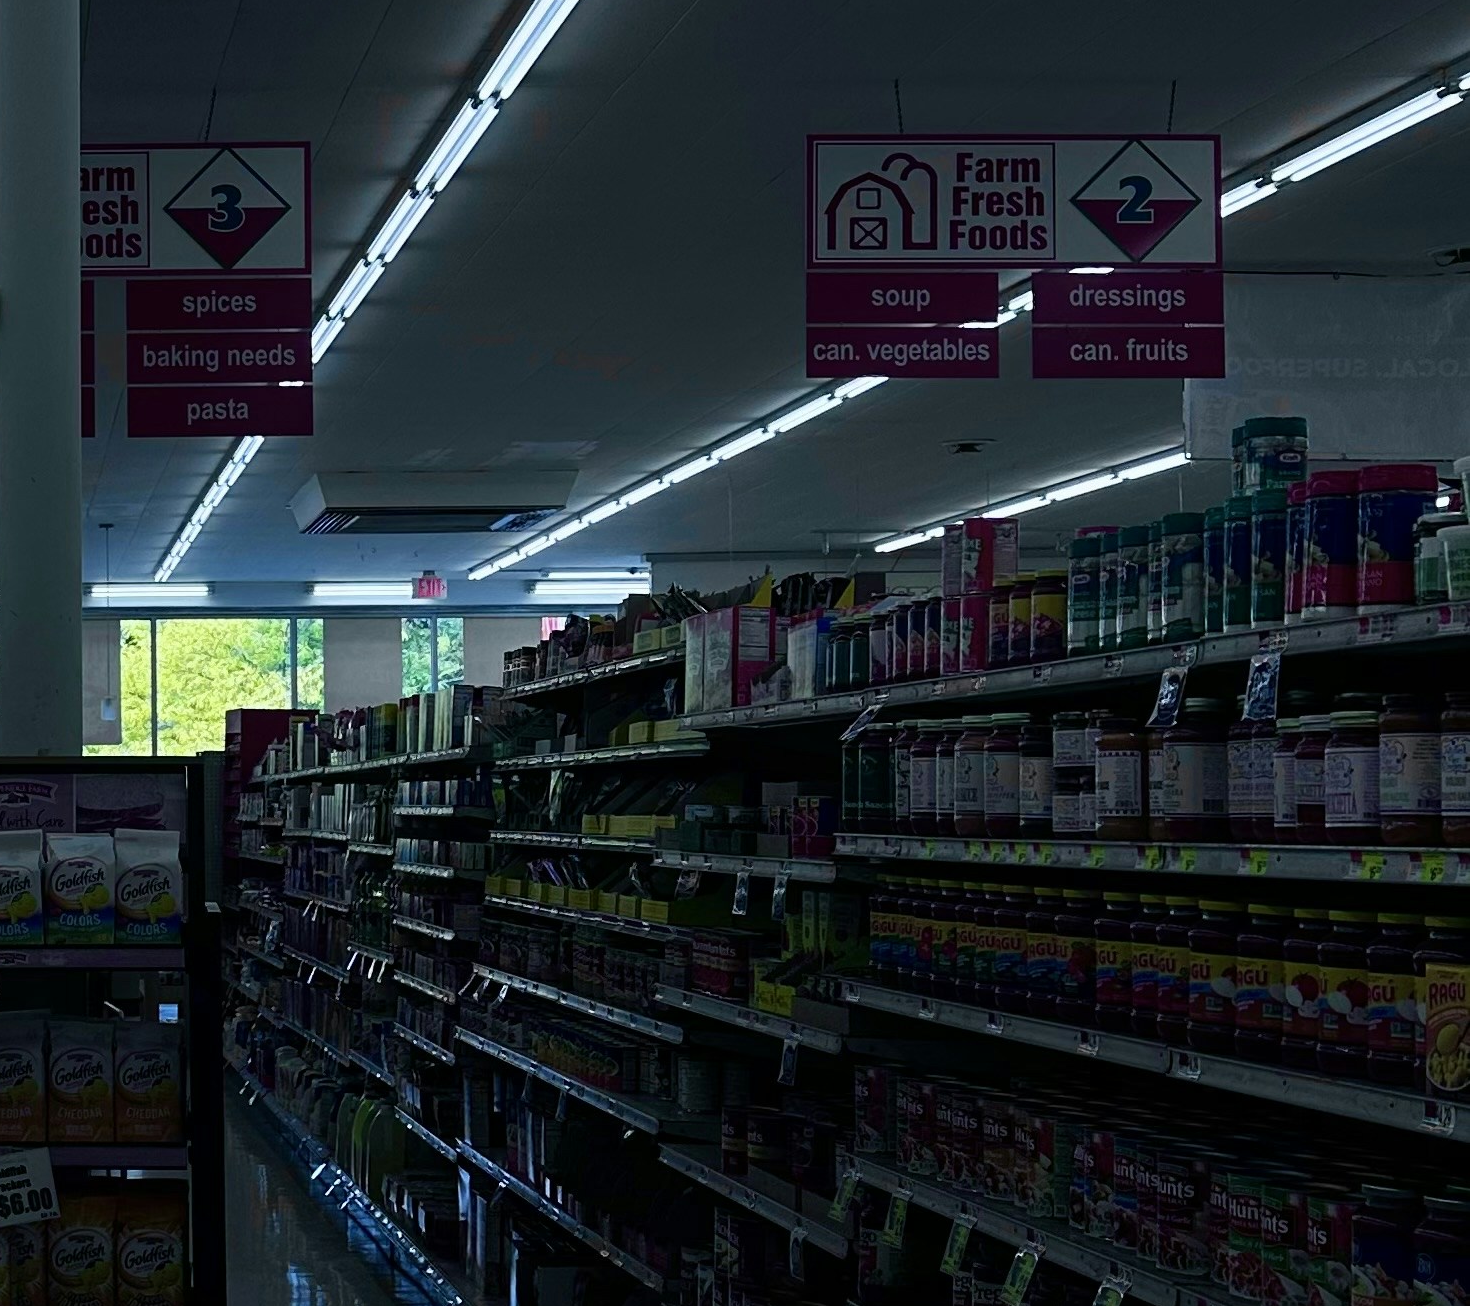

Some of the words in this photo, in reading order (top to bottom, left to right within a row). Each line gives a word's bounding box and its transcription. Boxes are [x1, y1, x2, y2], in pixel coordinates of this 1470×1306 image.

[80, 166, 135, 191] arm
[957, 153, 1040, 183] Farm
[82, 196, 139, 225] esh
[207, 183, 246, 232] 3
[952, 186, 1045, 216] Fresh
[1117, 175, 1154, 223] 2
[80, 232, 141, 259] ods
[950, 220, 1048, 251] Foods
[182, 290, 257, 315] spices
[871, 288, 930, 310] soup
[1069, 285, 1186, 312] dressings
[143, 345, 219, 372] baking
[227, 344, 296, 367] needs
[813, 343, 860, 361] can.
[867, 339, 990, 366] vegetables
[1070, 343, 1119, 361] can.
[1127, 339, 1189, 361] fruits
[187, 400, 249, 424] pasta
[418, 578, 442, 598] EXIT
[7, 808, 32, 827] with
[37, 809, 65, 828] Care
[54, 868, 105, 893] Goldfish
[121, 876, 171, 902] Goldfish
[59, 912, 101, 927] COLORS
[126, 922, 168, 936] COLORS
[55, 1061, 106, 1086] Goldfish
[123, 1061, 171, 1087] Goldfish
[57, 1107, 102, 1120] CHEDDAR
[126, 1106, 171, 1120] CHEDDAR
[55, 1244, 105, 1268] Goldfish
[123, 1244, 173, 1269] Goldfish
